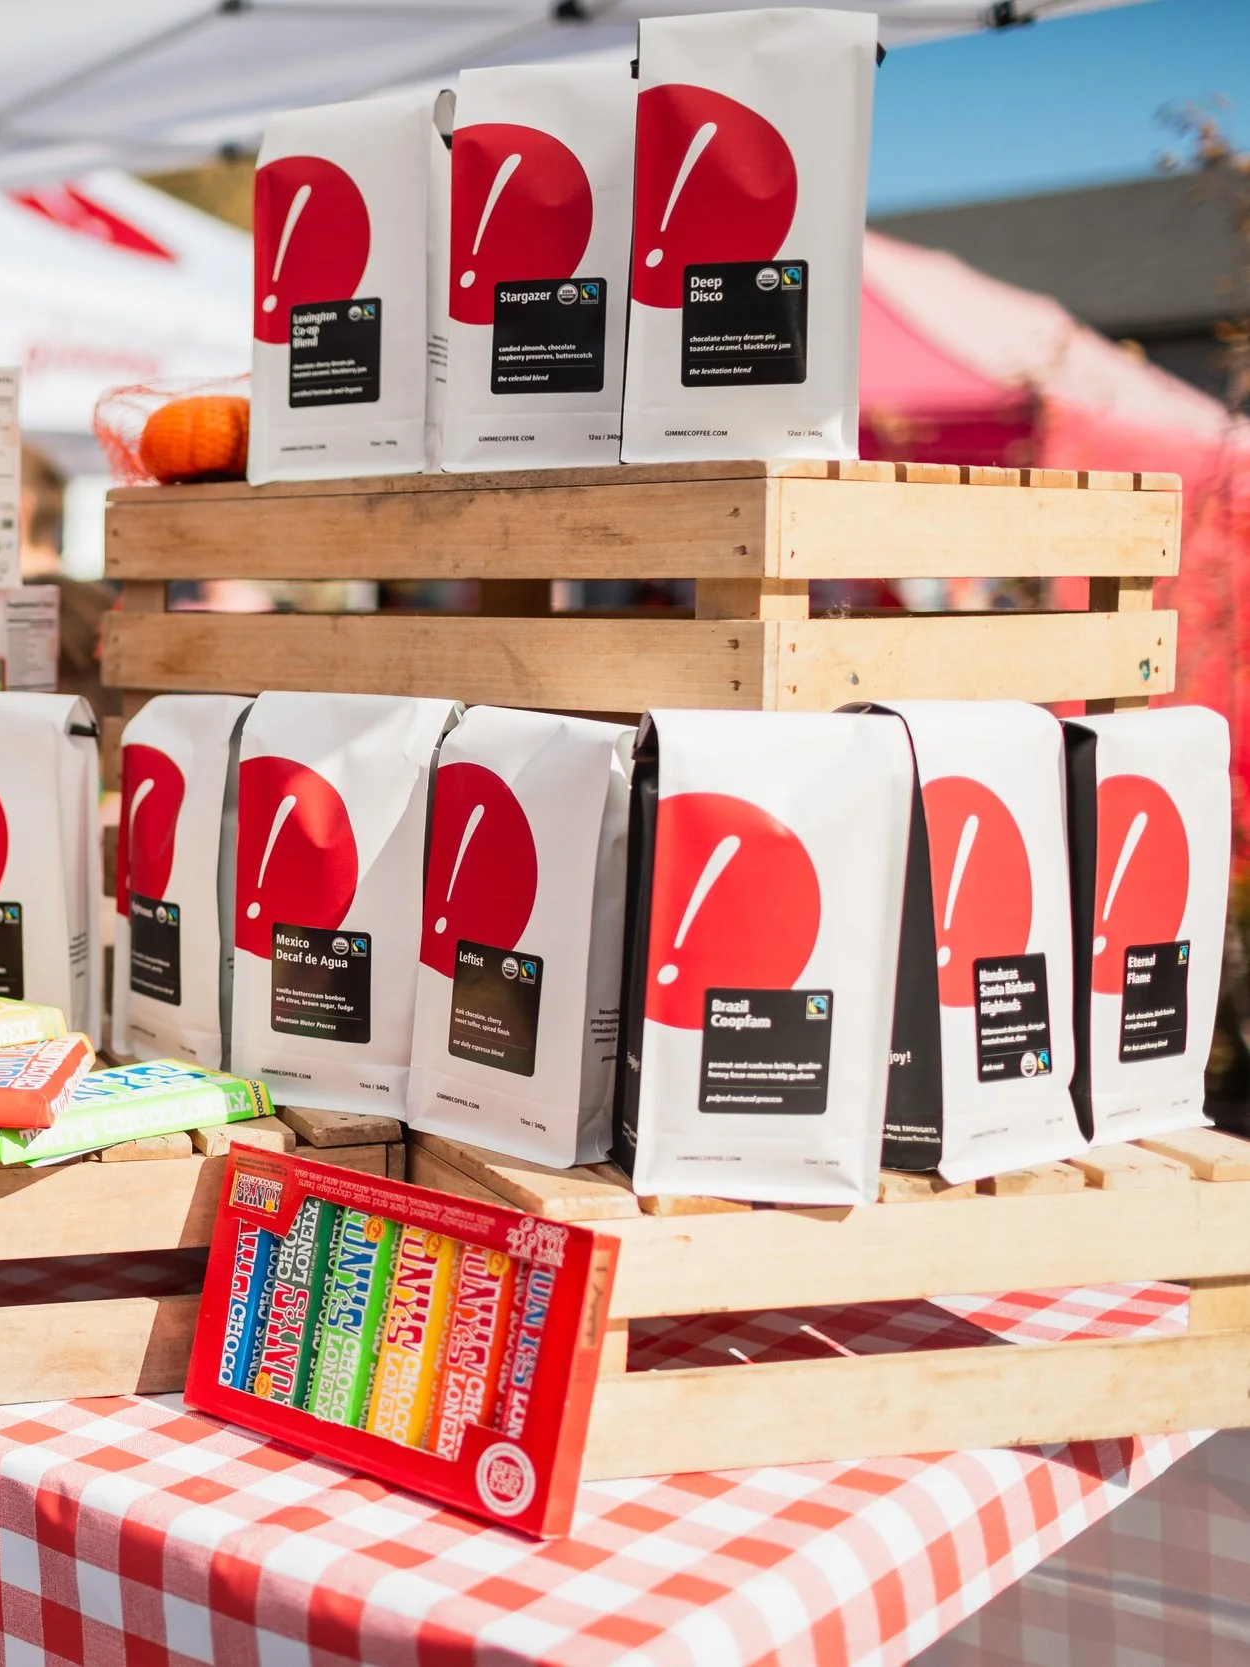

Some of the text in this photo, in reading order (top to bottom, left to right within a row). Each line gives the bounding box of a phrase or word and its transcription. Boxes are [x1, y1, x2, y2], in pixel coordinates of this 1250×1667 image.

[690, 276, 723, 290] Deep
[500, 291, 551, 304] Stargazer
[690, 290, 723, 302] Disco
[292, 311, 337, 326] Lexington
[292, 325, 320, 338] Co-op
[690, 333, 776, 343] chocolate cherry dream pie
[292, 336, 318, 349] Blend
[521, 344, 547, 352] almonds,
[548, 343, 576, 351] chocolate
[689, 342, 791, 352] toasted caramel, blackberry jam
[498, 352, 593, 362] raspberry preserves, butterscotch
[508, 374, 532, 382] celestial
[532, 373, 549, 381] blend
[701, 367, 732, 375] levitation
[733, 366, 752, 374] blend
[478, 434, 535, 442] GIMMECOFFEE.COM
[807, 430, 823, 438] 340g
[276, 933, 310, 949] Mexico
[276, 949, 348, 970] Decaf de Agua
[459, 950, 484, 967] Leftist
[1127, 954, 1156, 968] Eternal
[978, 967, 1019, 983] Honduras
[1126, 972, 1152, 985] Flame
[276, 987, 346, 1002] vanilla buttercream bonbon
[979, 983, 1005, 998] Santa
[276, 995, 354, 1012] soft citrus, brown sugar, fudge
[711, 999, 750, 1013] Brazil
[980, 999, 1022, 1016] Highlands
[276, 1015, 336, 1030] Mountain Water Process
[455, 1007, 502, 1026] dark chocolate, cherry
[710, 1014, 772, 1030] Coopfam
[454, 1017, 510, 1036] sweet toffee, spiced finish
[460, 1039, 471, 1049] daily
[471, 1043, 491, 1054] espresso
[491, 1047, 504, 1058] blend
[889, 1049, 911, 1066] joy!
[261, 1067, 312, 1080] GIMMECOFFEE.COM
[436, 1092, 480, 1110] GIMMECOFFEE.COM
[296, 1177, 315, 1190] bars
[307, 1171, 322, 1182] sea
[322, 1175, 338, 1187] and
[315, 1182, 351, 1199] chocolate
[338, 1179, 369, 1195] almond
[351, 1191, 370, 1204] milk
[219, 1303, 248, 1386] CHOCO
[315, 1332, 343, 1422] LONELY
[330, 1339, 361, 1424] CHOCO
[373, 1352, 403, 1438] LONELY
[391, 1355, 423, 1446] CHOCO
[437, 1370, 466, 1461] LONELY
